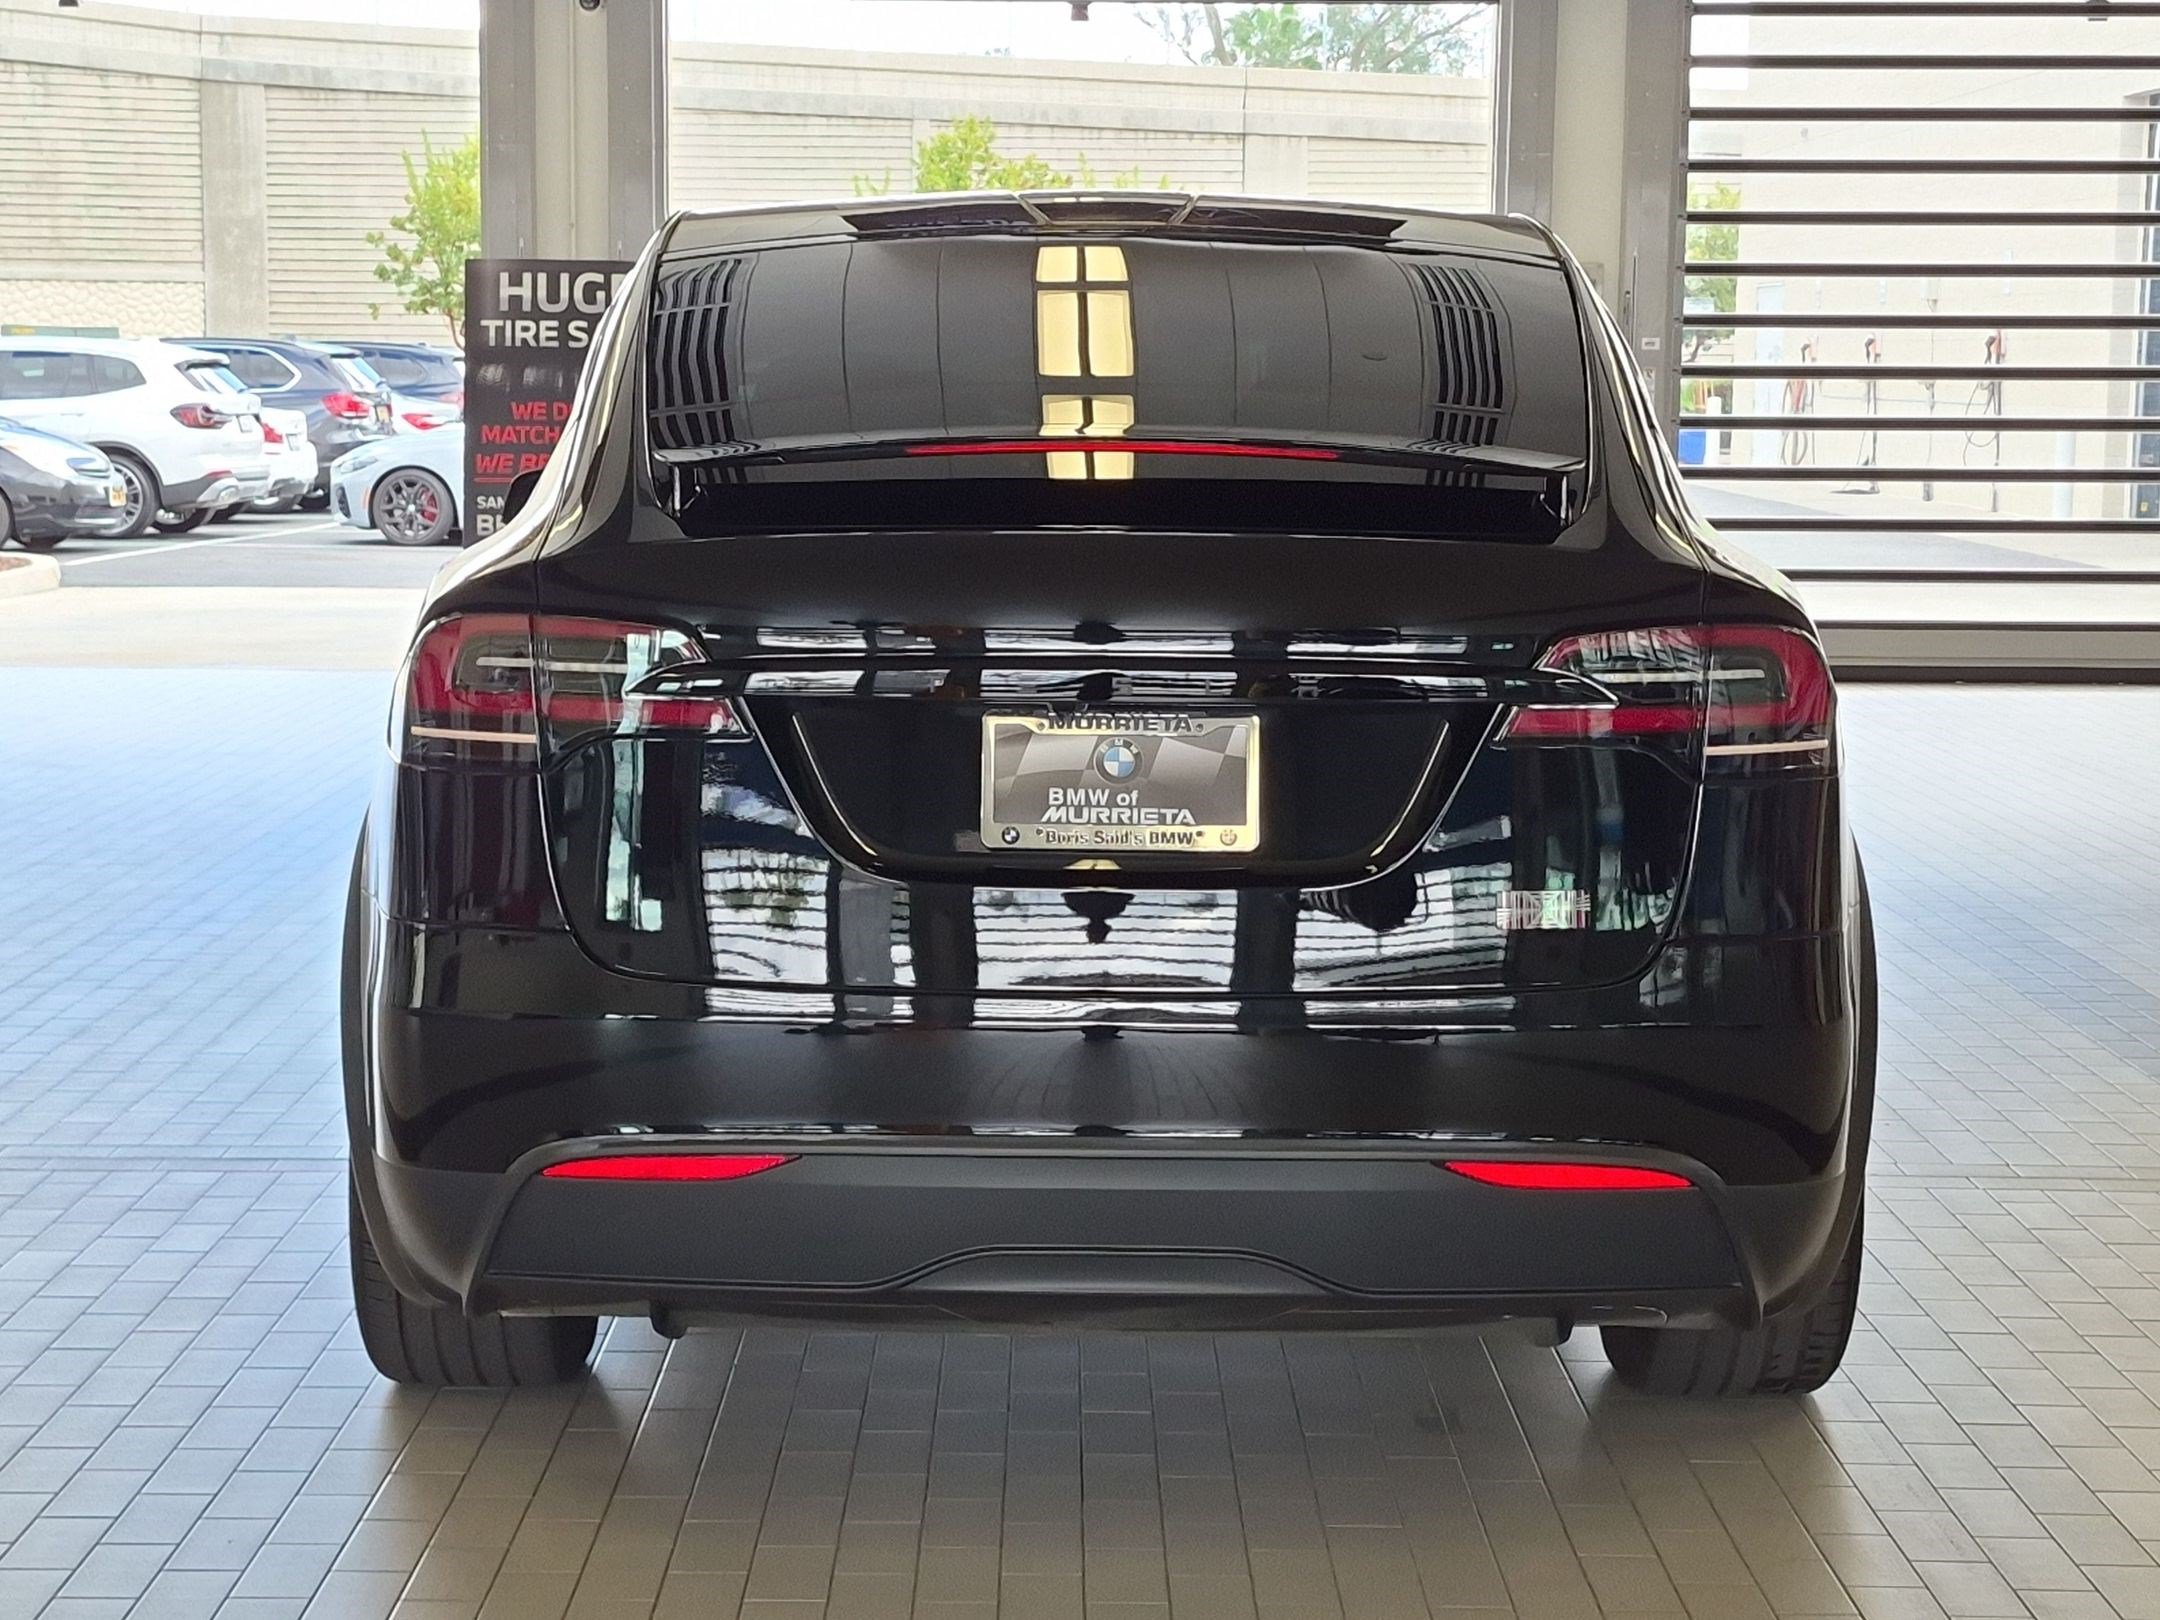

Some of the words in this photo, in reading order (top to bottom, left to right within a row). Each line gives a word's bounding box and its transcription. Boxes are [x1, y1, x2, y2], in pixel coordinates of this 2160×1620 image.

[479, 319, 559, 347] TIRE
[567, 319, 589, 348] S
[511, 401, 546, 420] WE
[552, 401, 574, 420] D
[475, 453, 514, 474] WE
[1048, 712, 1192, 732] MURRIETA
[1048, 788, 1110, 806] BMW
[1116, 790, 1139, 806] of
[1040, 807, 1196, 825] MURRIETA
[1046, 829, 1089, 844] Boris
[1148, 831, 1193, 845] BMW
